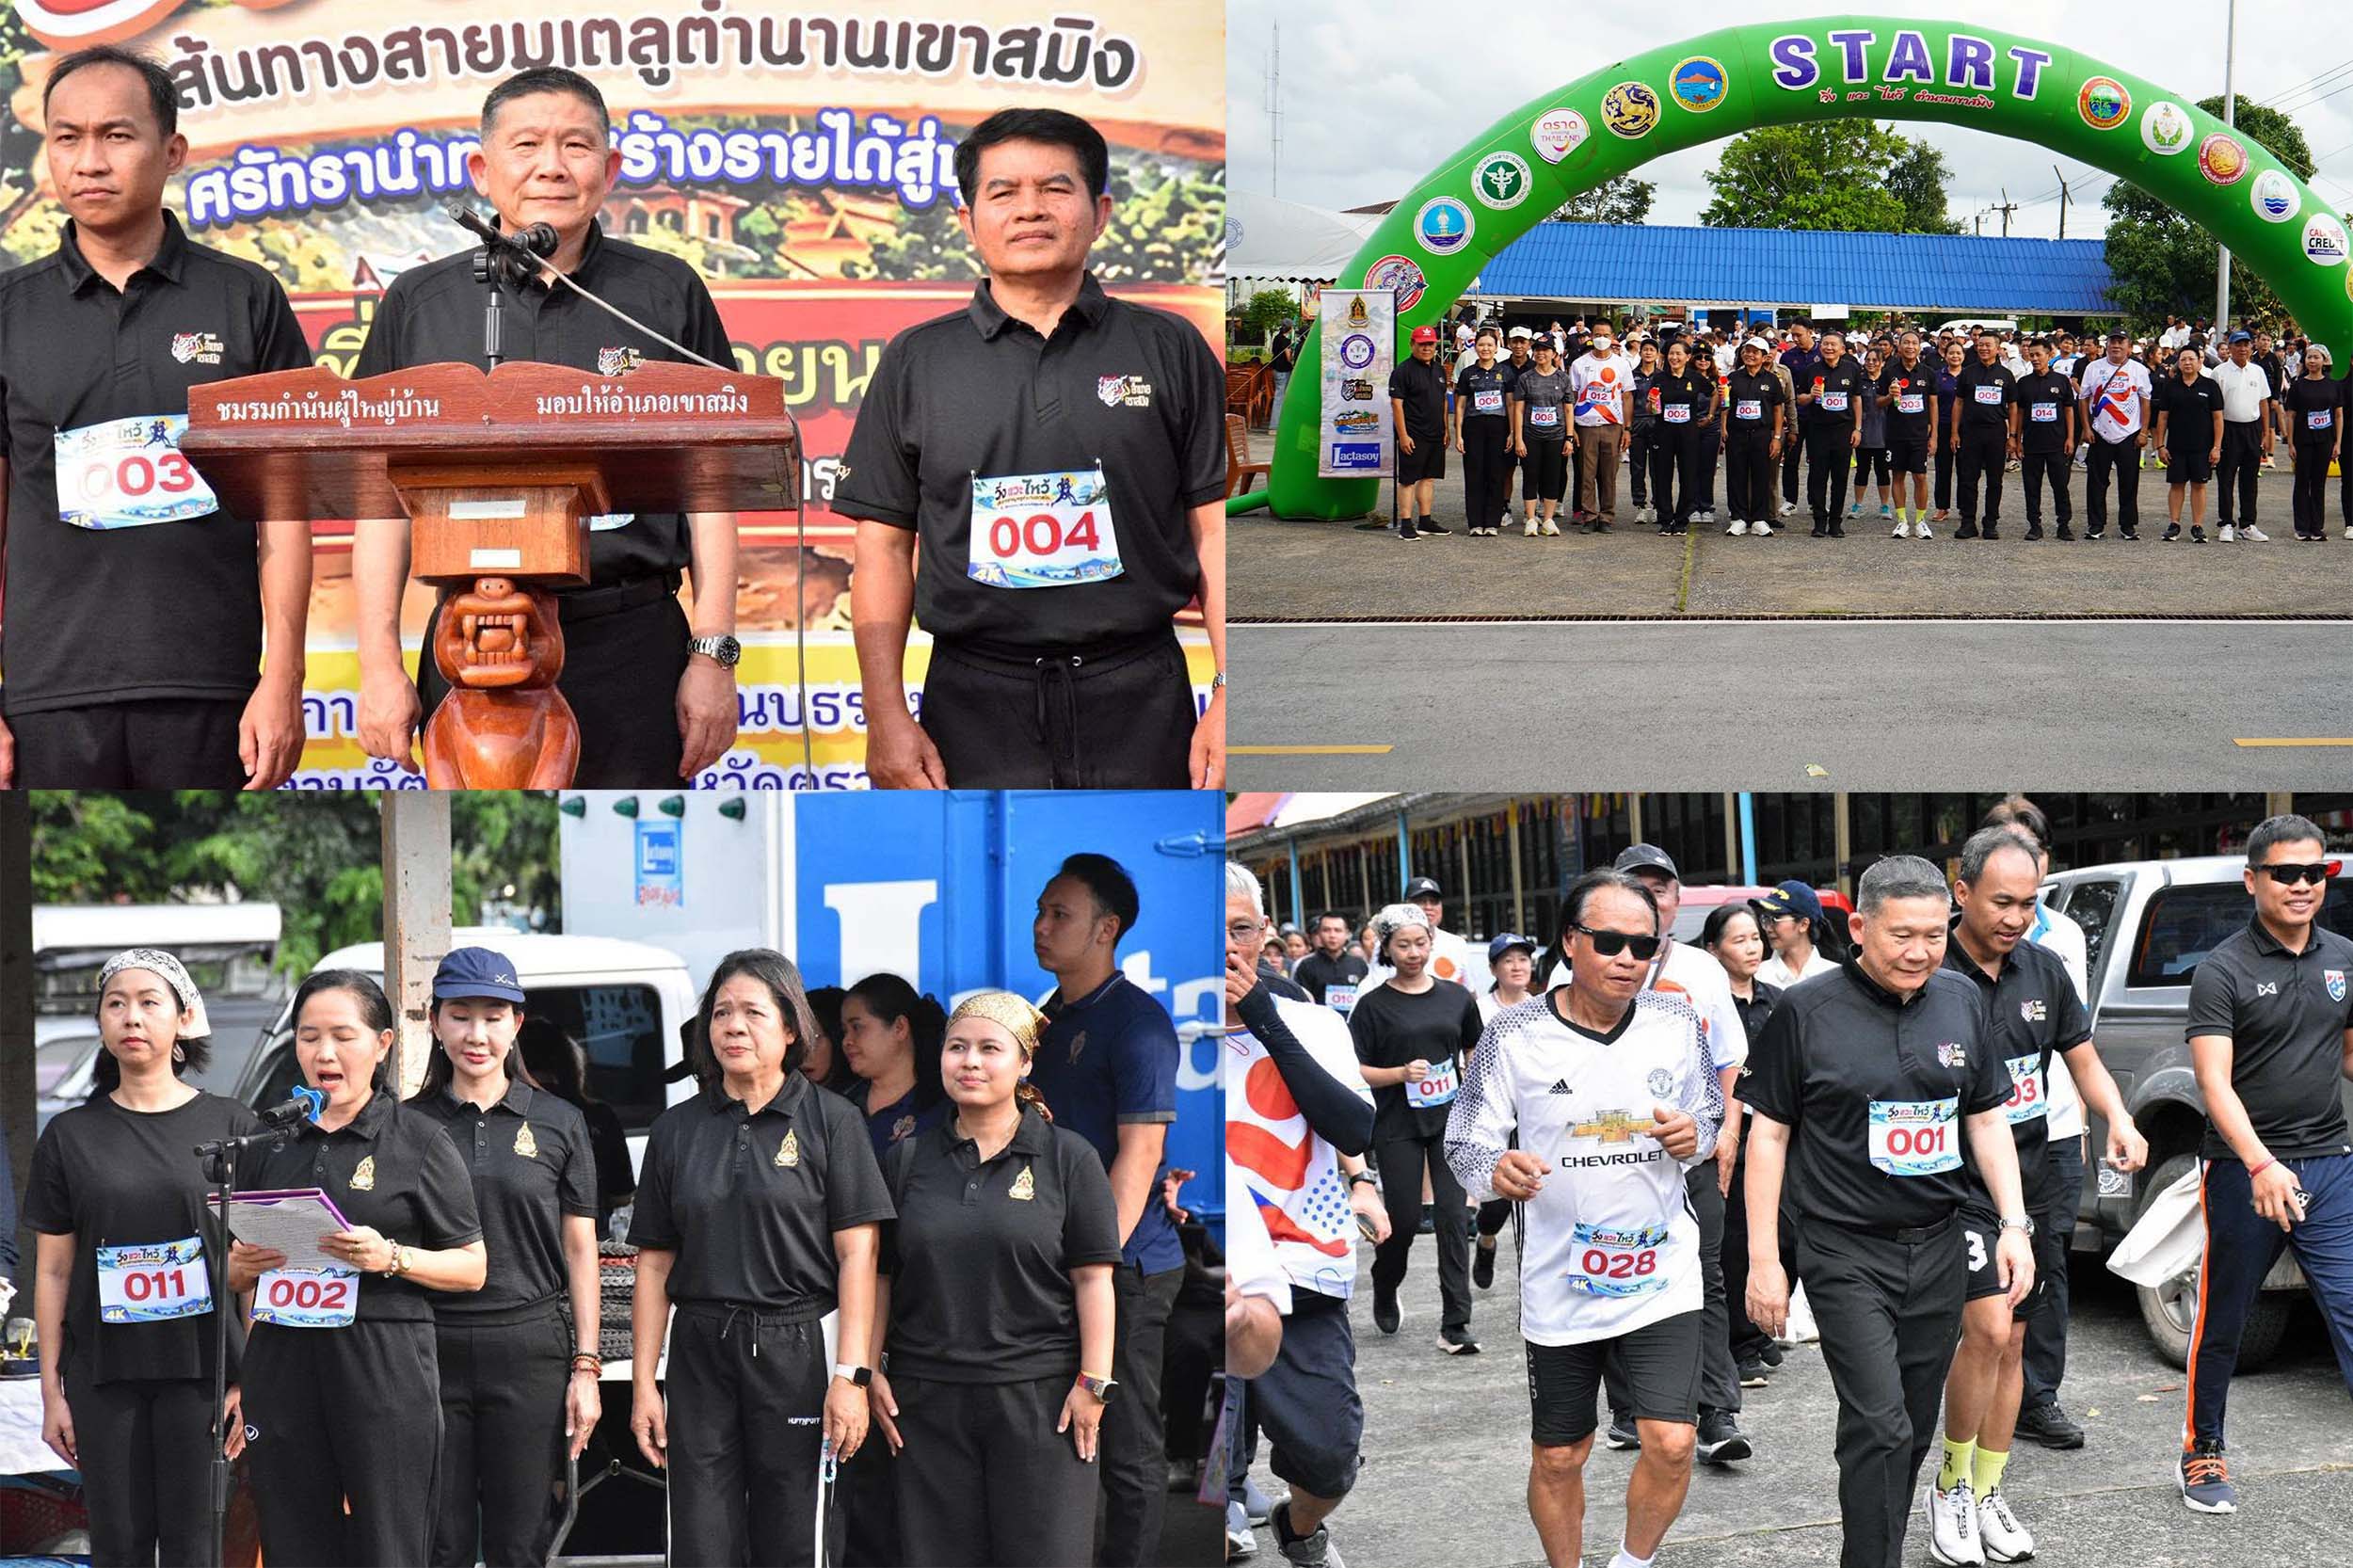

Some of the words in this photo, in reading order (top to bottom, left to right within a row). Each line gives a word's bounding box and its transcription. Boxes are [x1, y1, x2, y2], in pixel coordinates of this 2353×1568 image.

[1772, 31, 2049, 97] START
[536, 383, 749, 415] มอบให้อำเภอเขาสมิง
[1479, 397, 1498, 406] 006
[1591, 392, 1608, 400] 012
[1826, 398, 1843, 407] 001
[1901, 400, 1920, 408] 003
[1978, 392, 1998, 400] 005
[216, 388, 440, 428] ชมรมกำนันผู้ใหญ่บ้าน
[1535, 413, 1554, 422] 008
[1333, 447, 1379, 467] Lactasoy
[990, 511, 1099, 557] 004
[1332, 994, 1353, 1003] 010
[1419, 1077, 1449, 1096] 011
[1887, 1126, 1945, 1156] 001
[1561, 1149, 1663, 1168] CHEVROLET
[1582, 1250, 1657, 1279] 028
[124, 1270, 185, 1302] 011
[269, 1279, 347, 1309] 002
